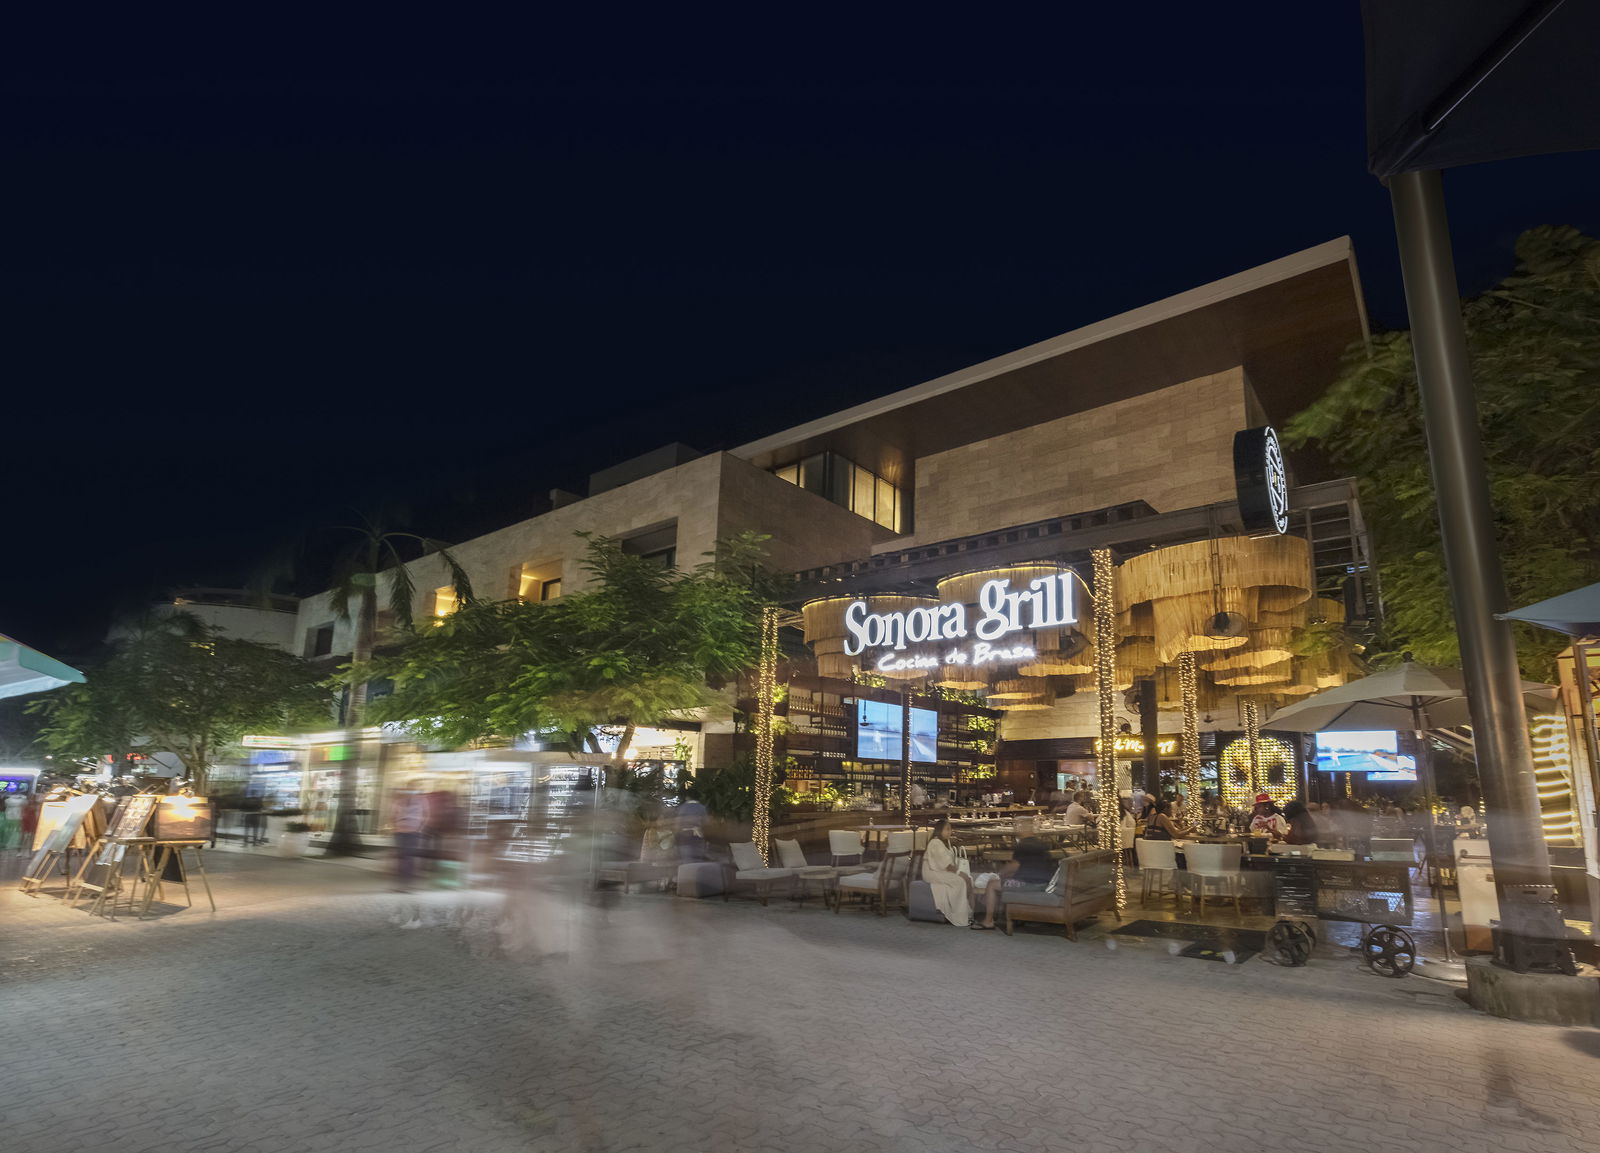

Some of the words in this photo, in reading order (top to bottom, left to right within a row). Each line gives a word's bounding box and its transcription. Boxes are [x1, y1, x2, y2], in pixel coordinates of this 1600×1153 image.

[843, 601, 968, 657] Sonora
[975, 571, 1078, 641] grill
[945, 647, 967, 664] de
